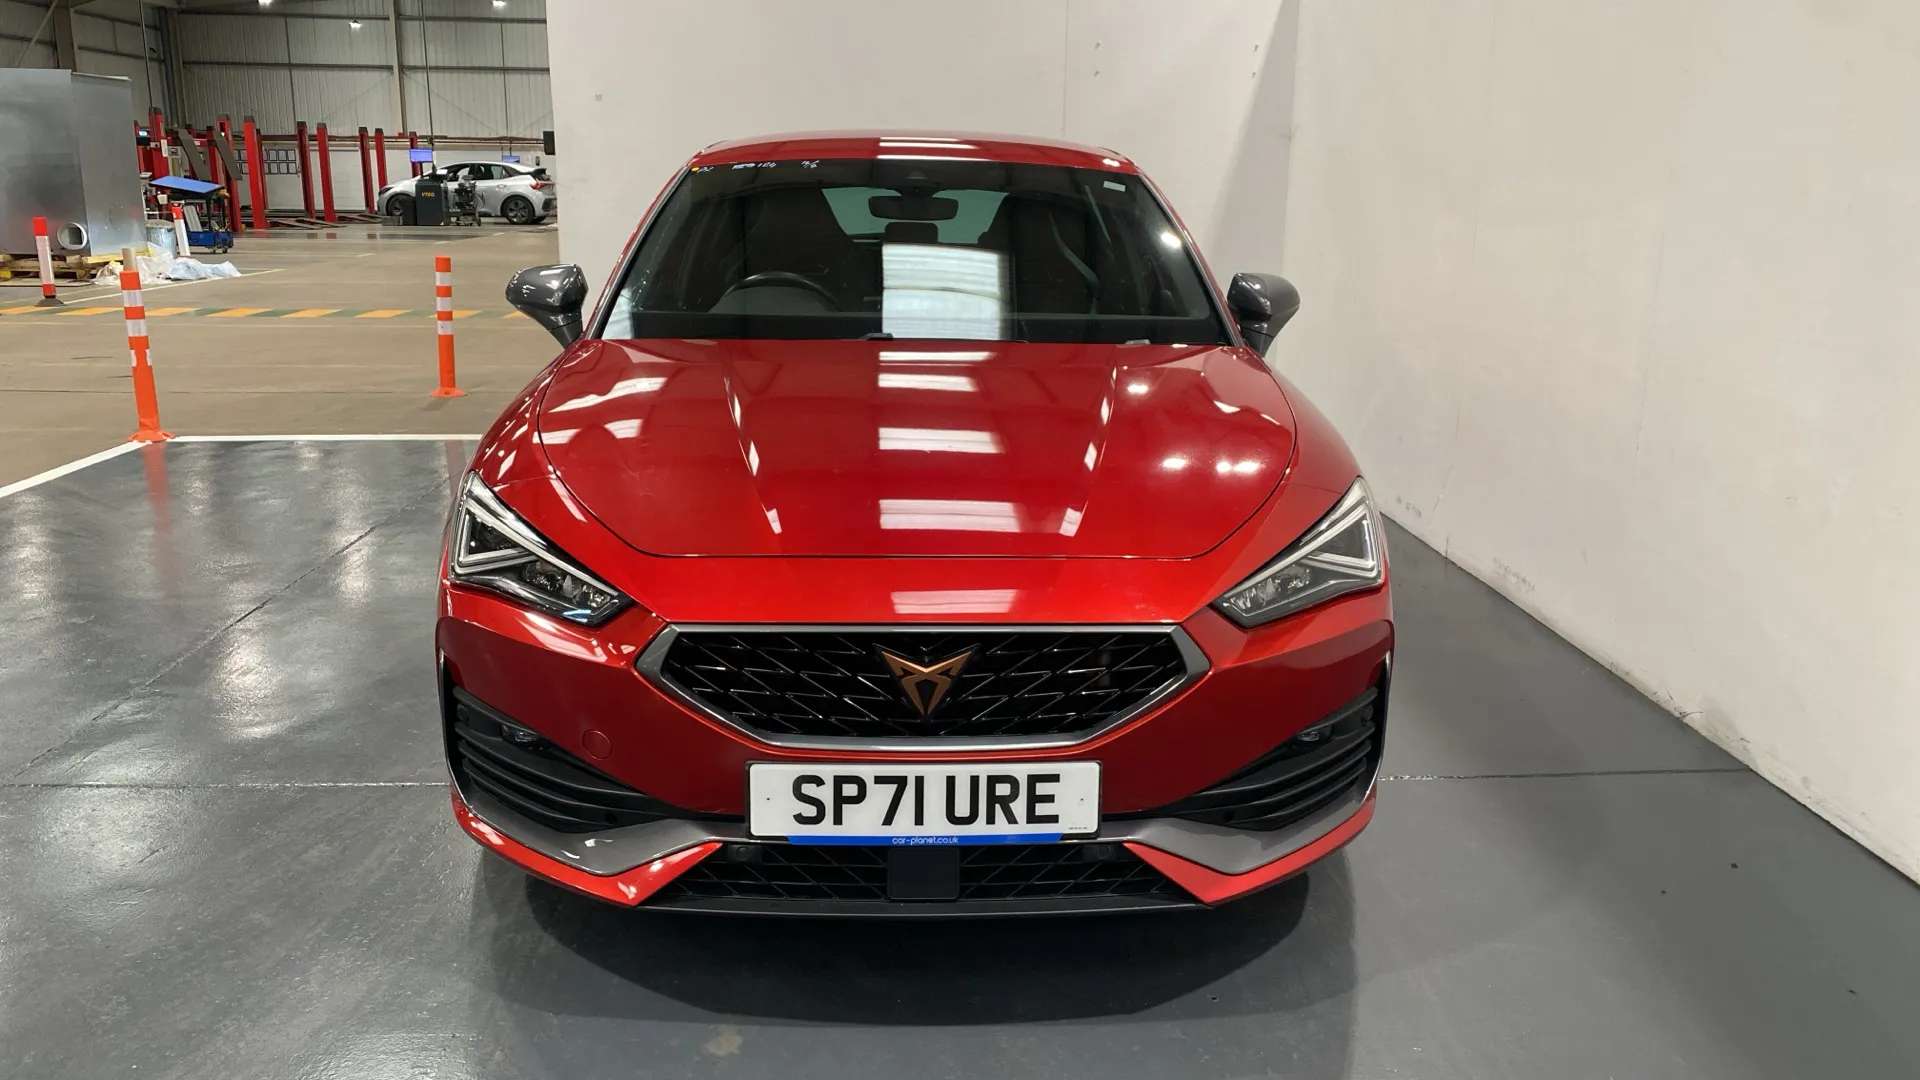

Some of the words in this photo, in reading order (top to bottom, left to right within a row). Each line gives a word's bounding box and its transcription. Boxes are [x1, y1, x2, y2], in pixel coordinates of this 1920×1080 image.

[792, 774, 925, 826] SP71
[945, 774, 1061, 825] URE
[892, 836, 958, 845] car-planet.co.uk
